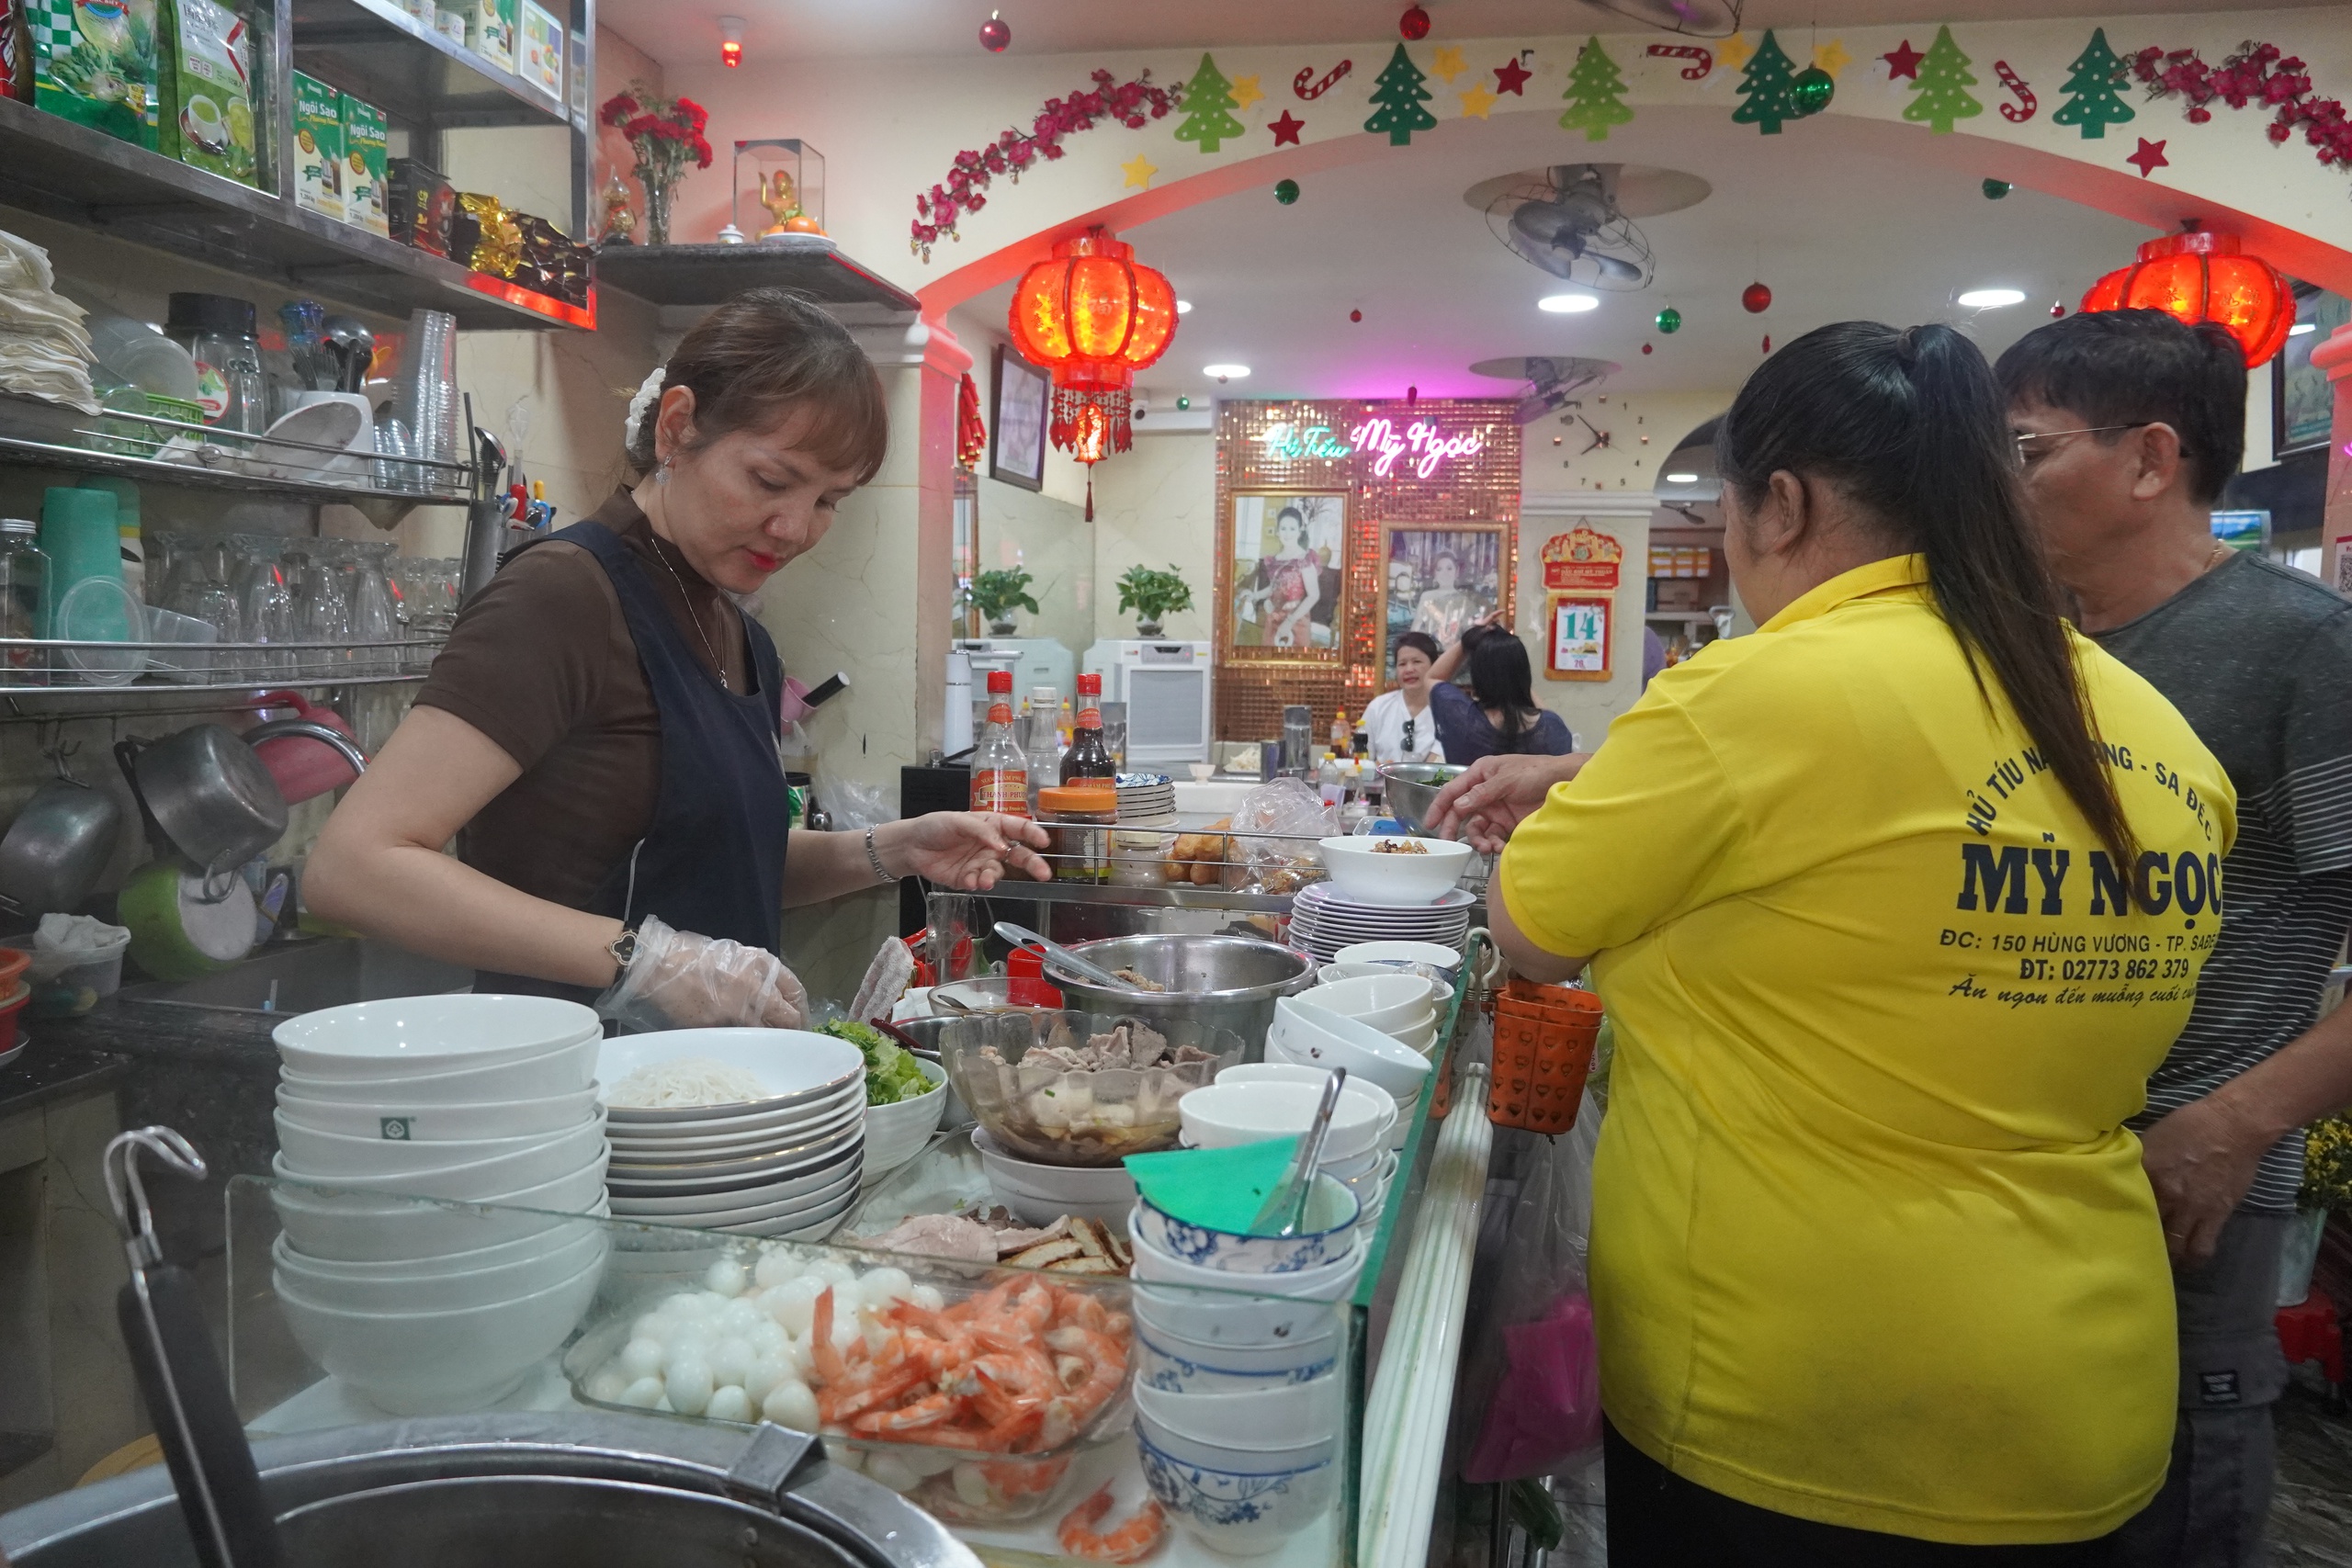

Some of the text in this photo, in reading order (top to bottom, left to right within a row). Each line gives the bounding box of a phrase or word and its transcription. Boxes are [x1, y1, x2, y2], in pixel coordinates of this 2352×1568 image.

[299, 100, 337, 118] Ngôi Sao
[350, 124, 386, 141] Ngôi Sao
[1637, 415, 1644, 425] 2
[1634, 459, 1640, 468] 4
[1580, 478, 1586, 486] 7
[1620, 478, 1626, 487] 5
[1563, 612, 1598, 640] 14
[1966, 789, 1996, 837] HỦ
[1985, 757, 2024, 800] TÍU
[2154, 761, 2179, 797] SA
[1957, 831, 2222, 931] MỸ NGỌC
[1939, 929, 1983, 950] ĐC:
[1992, 933, 2026, 953] 150
[2032, 931, 2086, 953] HÙNG
[2092, 933, 2150, 953] VƯƠNG
[2166, 935, 2187, 953] TP.
[2019, 958, 2189, 981] ĐT: 02773 862 379
[1949, 973, 1988, 999] Ăn
[1997, 989, 2049, 1010] ngon
[2054, 986, 2086, 1005] đến
[2091, 983, 2145, 1009] muỗng
[2150, 984, 2181, 1002] cuối
